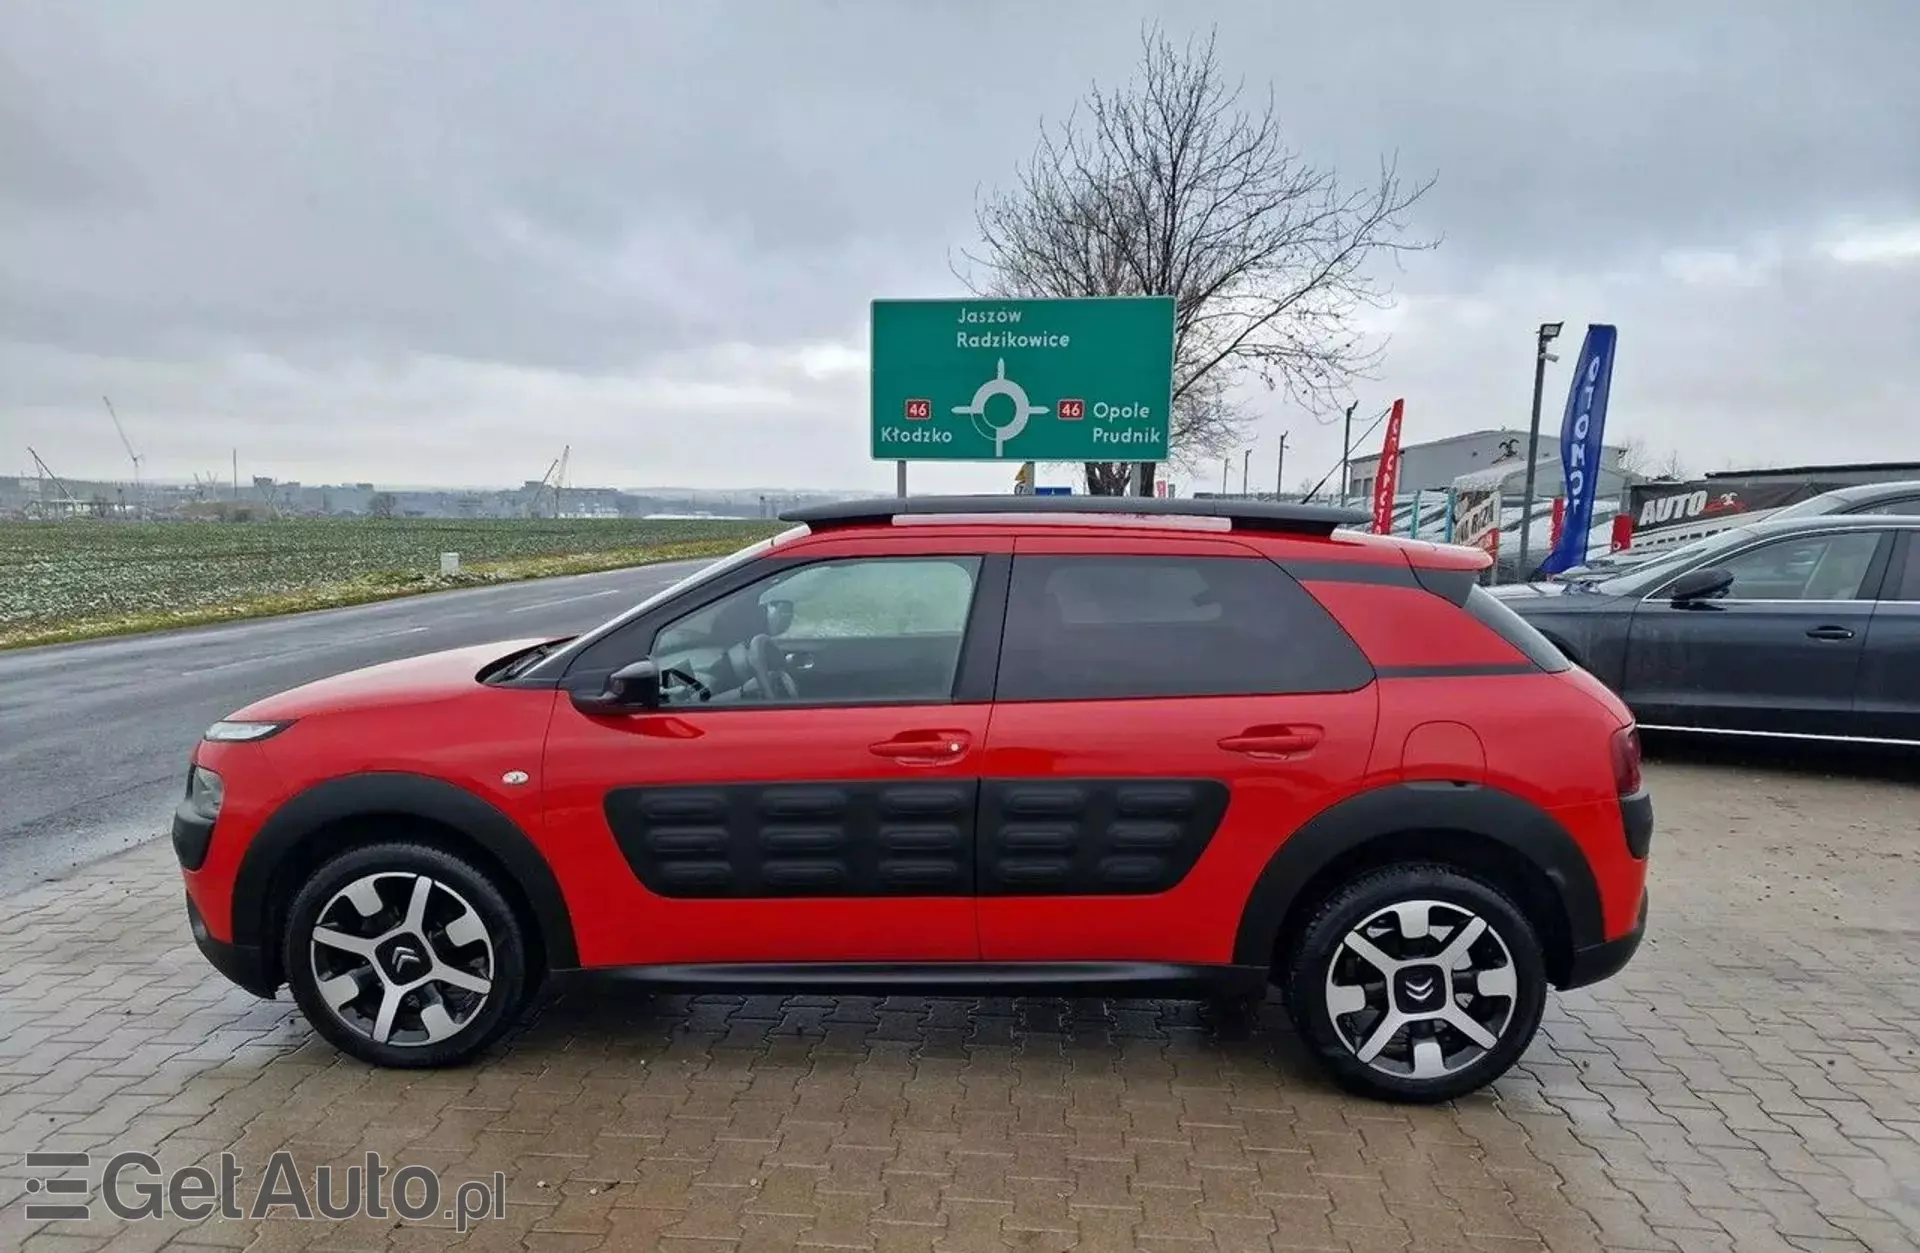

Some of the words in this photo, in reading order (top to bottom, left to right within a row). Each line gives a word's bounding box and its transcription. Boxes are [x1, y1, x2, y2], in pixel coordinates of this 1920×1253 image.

[957, 307, 1022, 324] Jaszów
[956, 331, 1071, 348] Radzikowice
[908, 402, 928, 417] 46
[1061, 402, 1081, 417] 46
[1093, 402, 1150, 422] Opole
[880, 426, 953, 444] Kłodzko
[1092, 427, 1161, 444] Prudnik
[1638, 490, 1709, 526] AUTO
